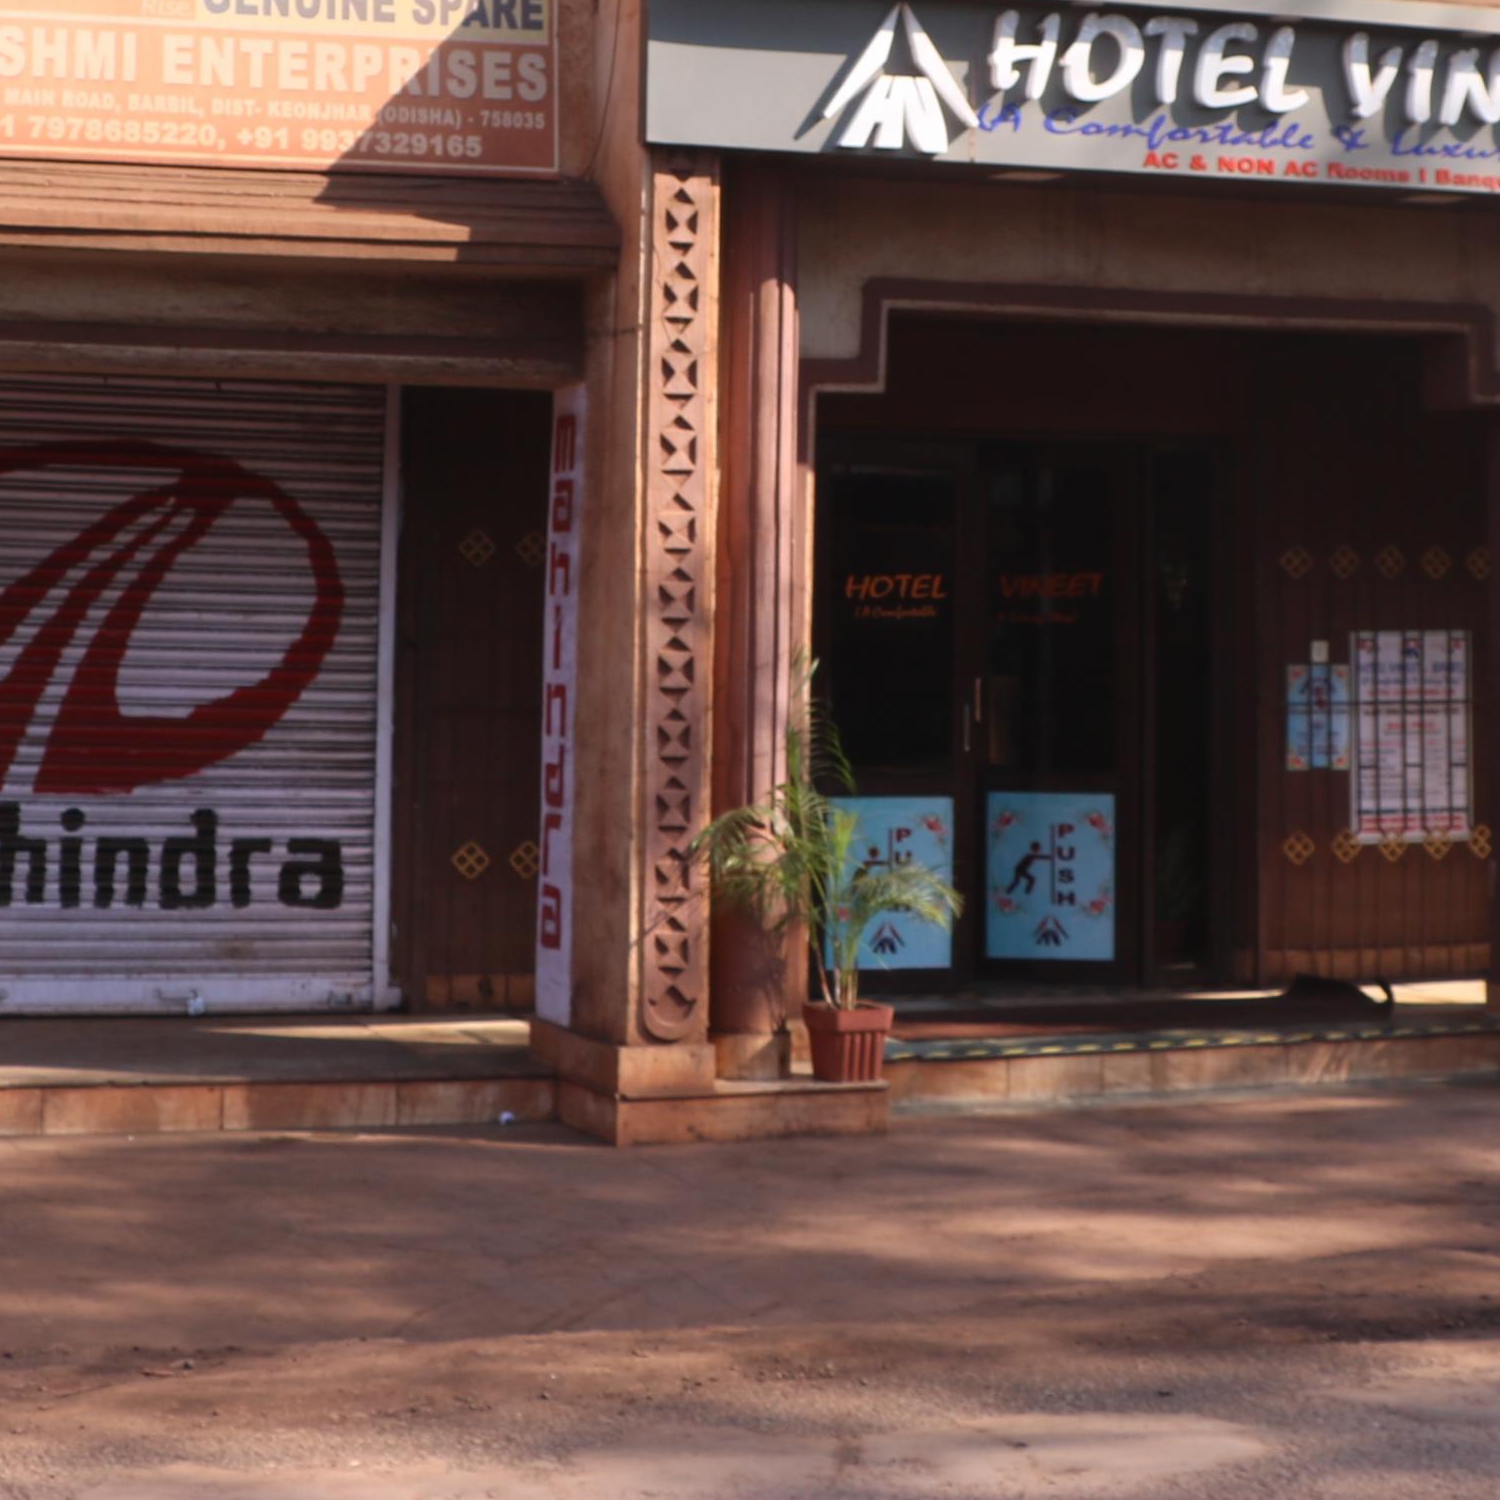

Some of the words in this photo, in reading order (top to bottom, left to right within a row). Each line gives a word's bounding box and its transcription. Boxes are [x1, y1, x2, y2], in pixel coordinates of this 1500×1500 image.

[163, 33, 548, 102] ENTERPRISES
[987, 9, 1310, 114] HOTEL
[4, 87, 55, 106] MAIN
[63, 90, 121, 112] ROAD,
[267, 99, 372, 122] KEONJHAR
[377, 105, 463, 130] (ODISHA)
[480, 110, 546, 130] 758035
[1043, 103, 1315, 150] Comfortable
[236, 126, 290, 151] +91
[302, 129, 484, 158] 9937329165
[1143, 151, 1180, 170] AC
[1188, 153, 1207, 172] &
[1217, 155, 1275, 175] NON
[1283, 159, 1319, 178] AC
[1327, 161, 1410, 184] Rooms
[845, 573, 948, 599] HOTEL
[1056, 823, 1077, 908] PUSH
